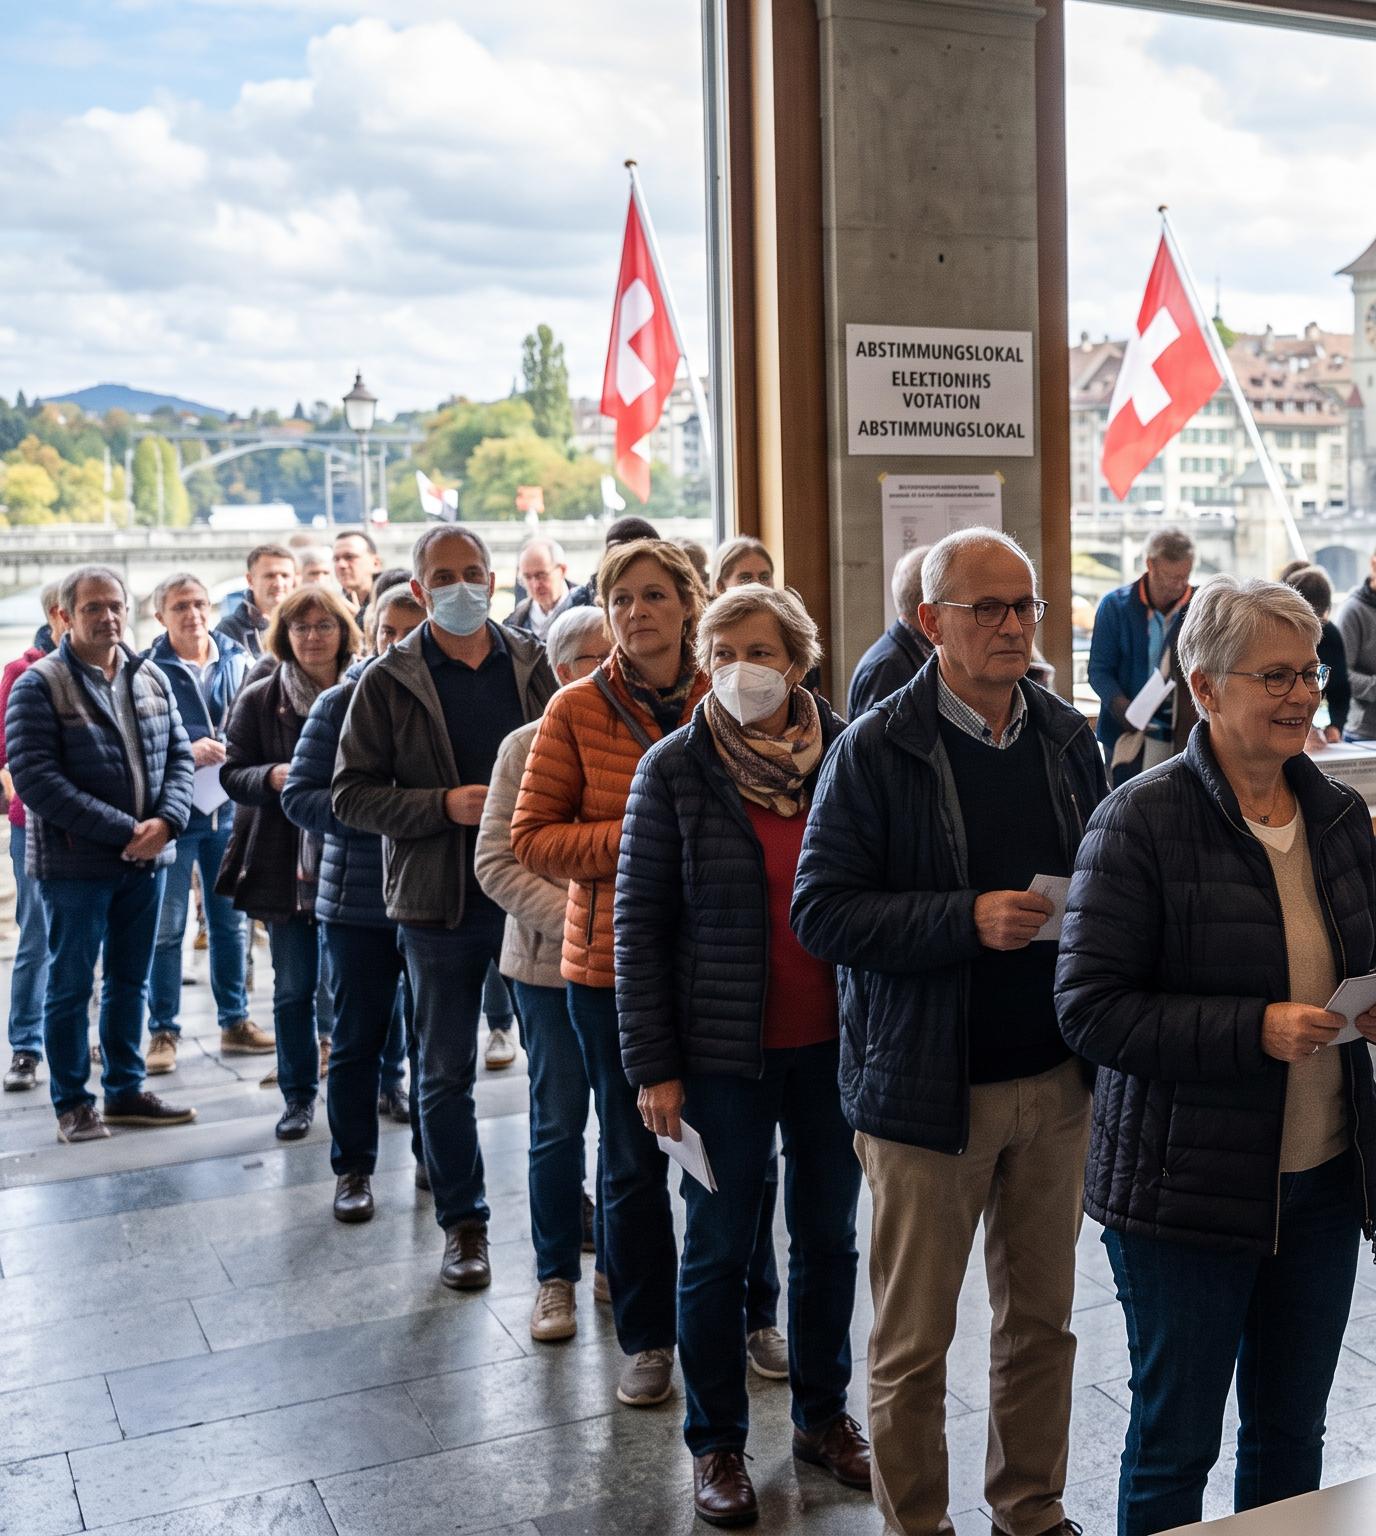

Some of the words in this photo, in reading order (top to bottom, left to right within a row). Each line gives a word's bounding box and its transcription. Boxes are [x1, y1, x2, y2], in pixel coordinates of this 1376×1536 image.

[856, 341, 1024, 363] ABSTIMMUNGSLOKAL
[902, 392, 980, 410] VOTATION
[857, 420, 1025, 439] ABSTIMMUNGSLOKAL
